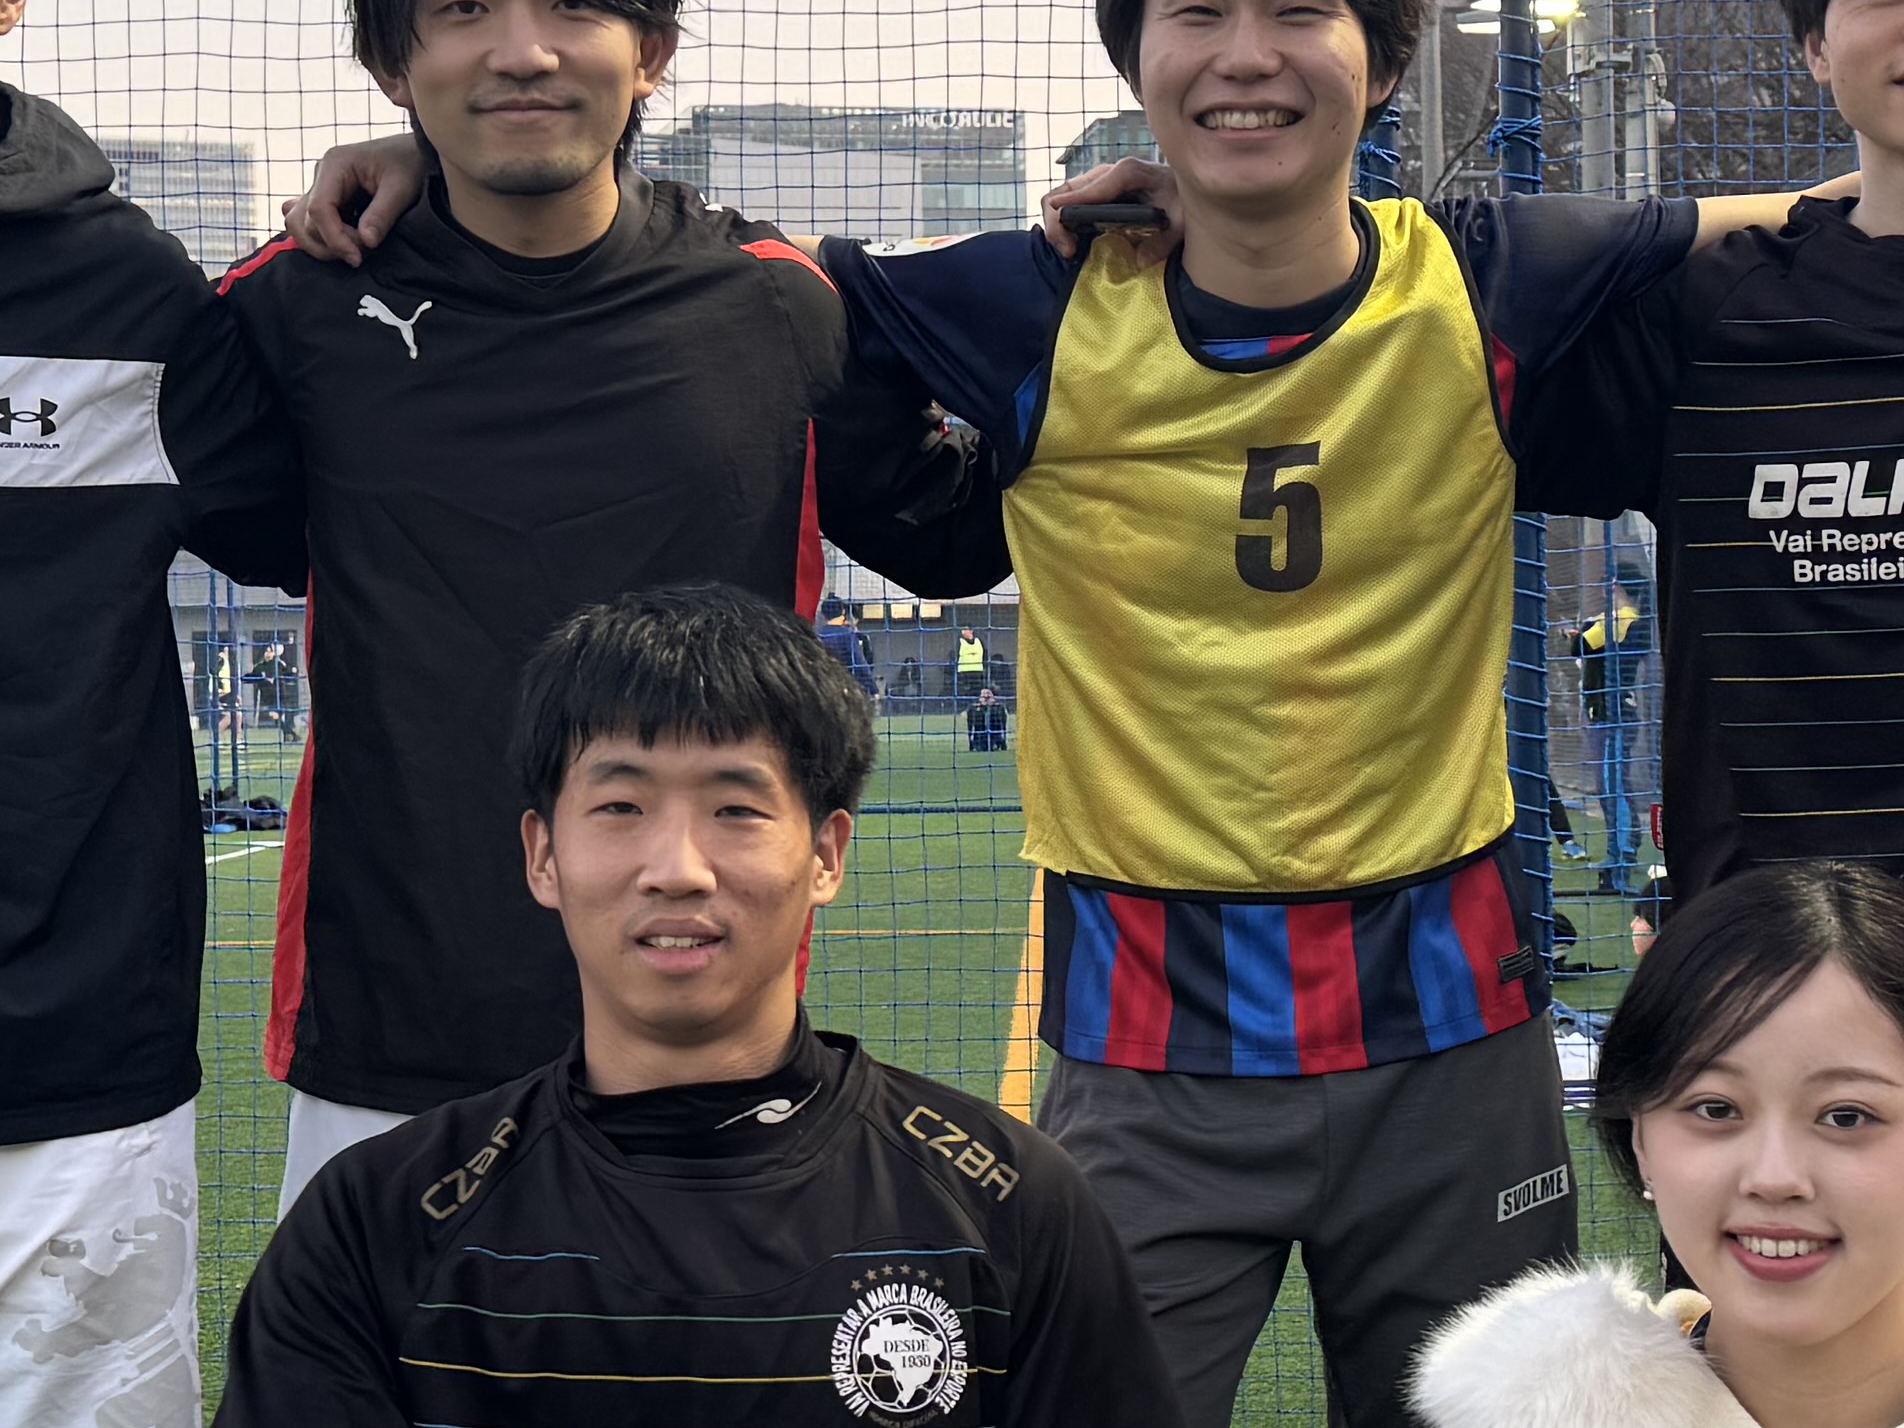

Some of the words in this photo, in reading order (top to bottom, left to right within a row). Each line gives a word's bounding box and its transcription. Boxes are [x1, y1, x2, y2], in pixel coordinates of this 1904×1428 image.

[1234, 440, 1324, 594] 5
[1769, 529, 1813, 554] Vai
[1502, 1169, 1565, 1217] SVOLME
[883, 1338, 931, 1354] DESDE
